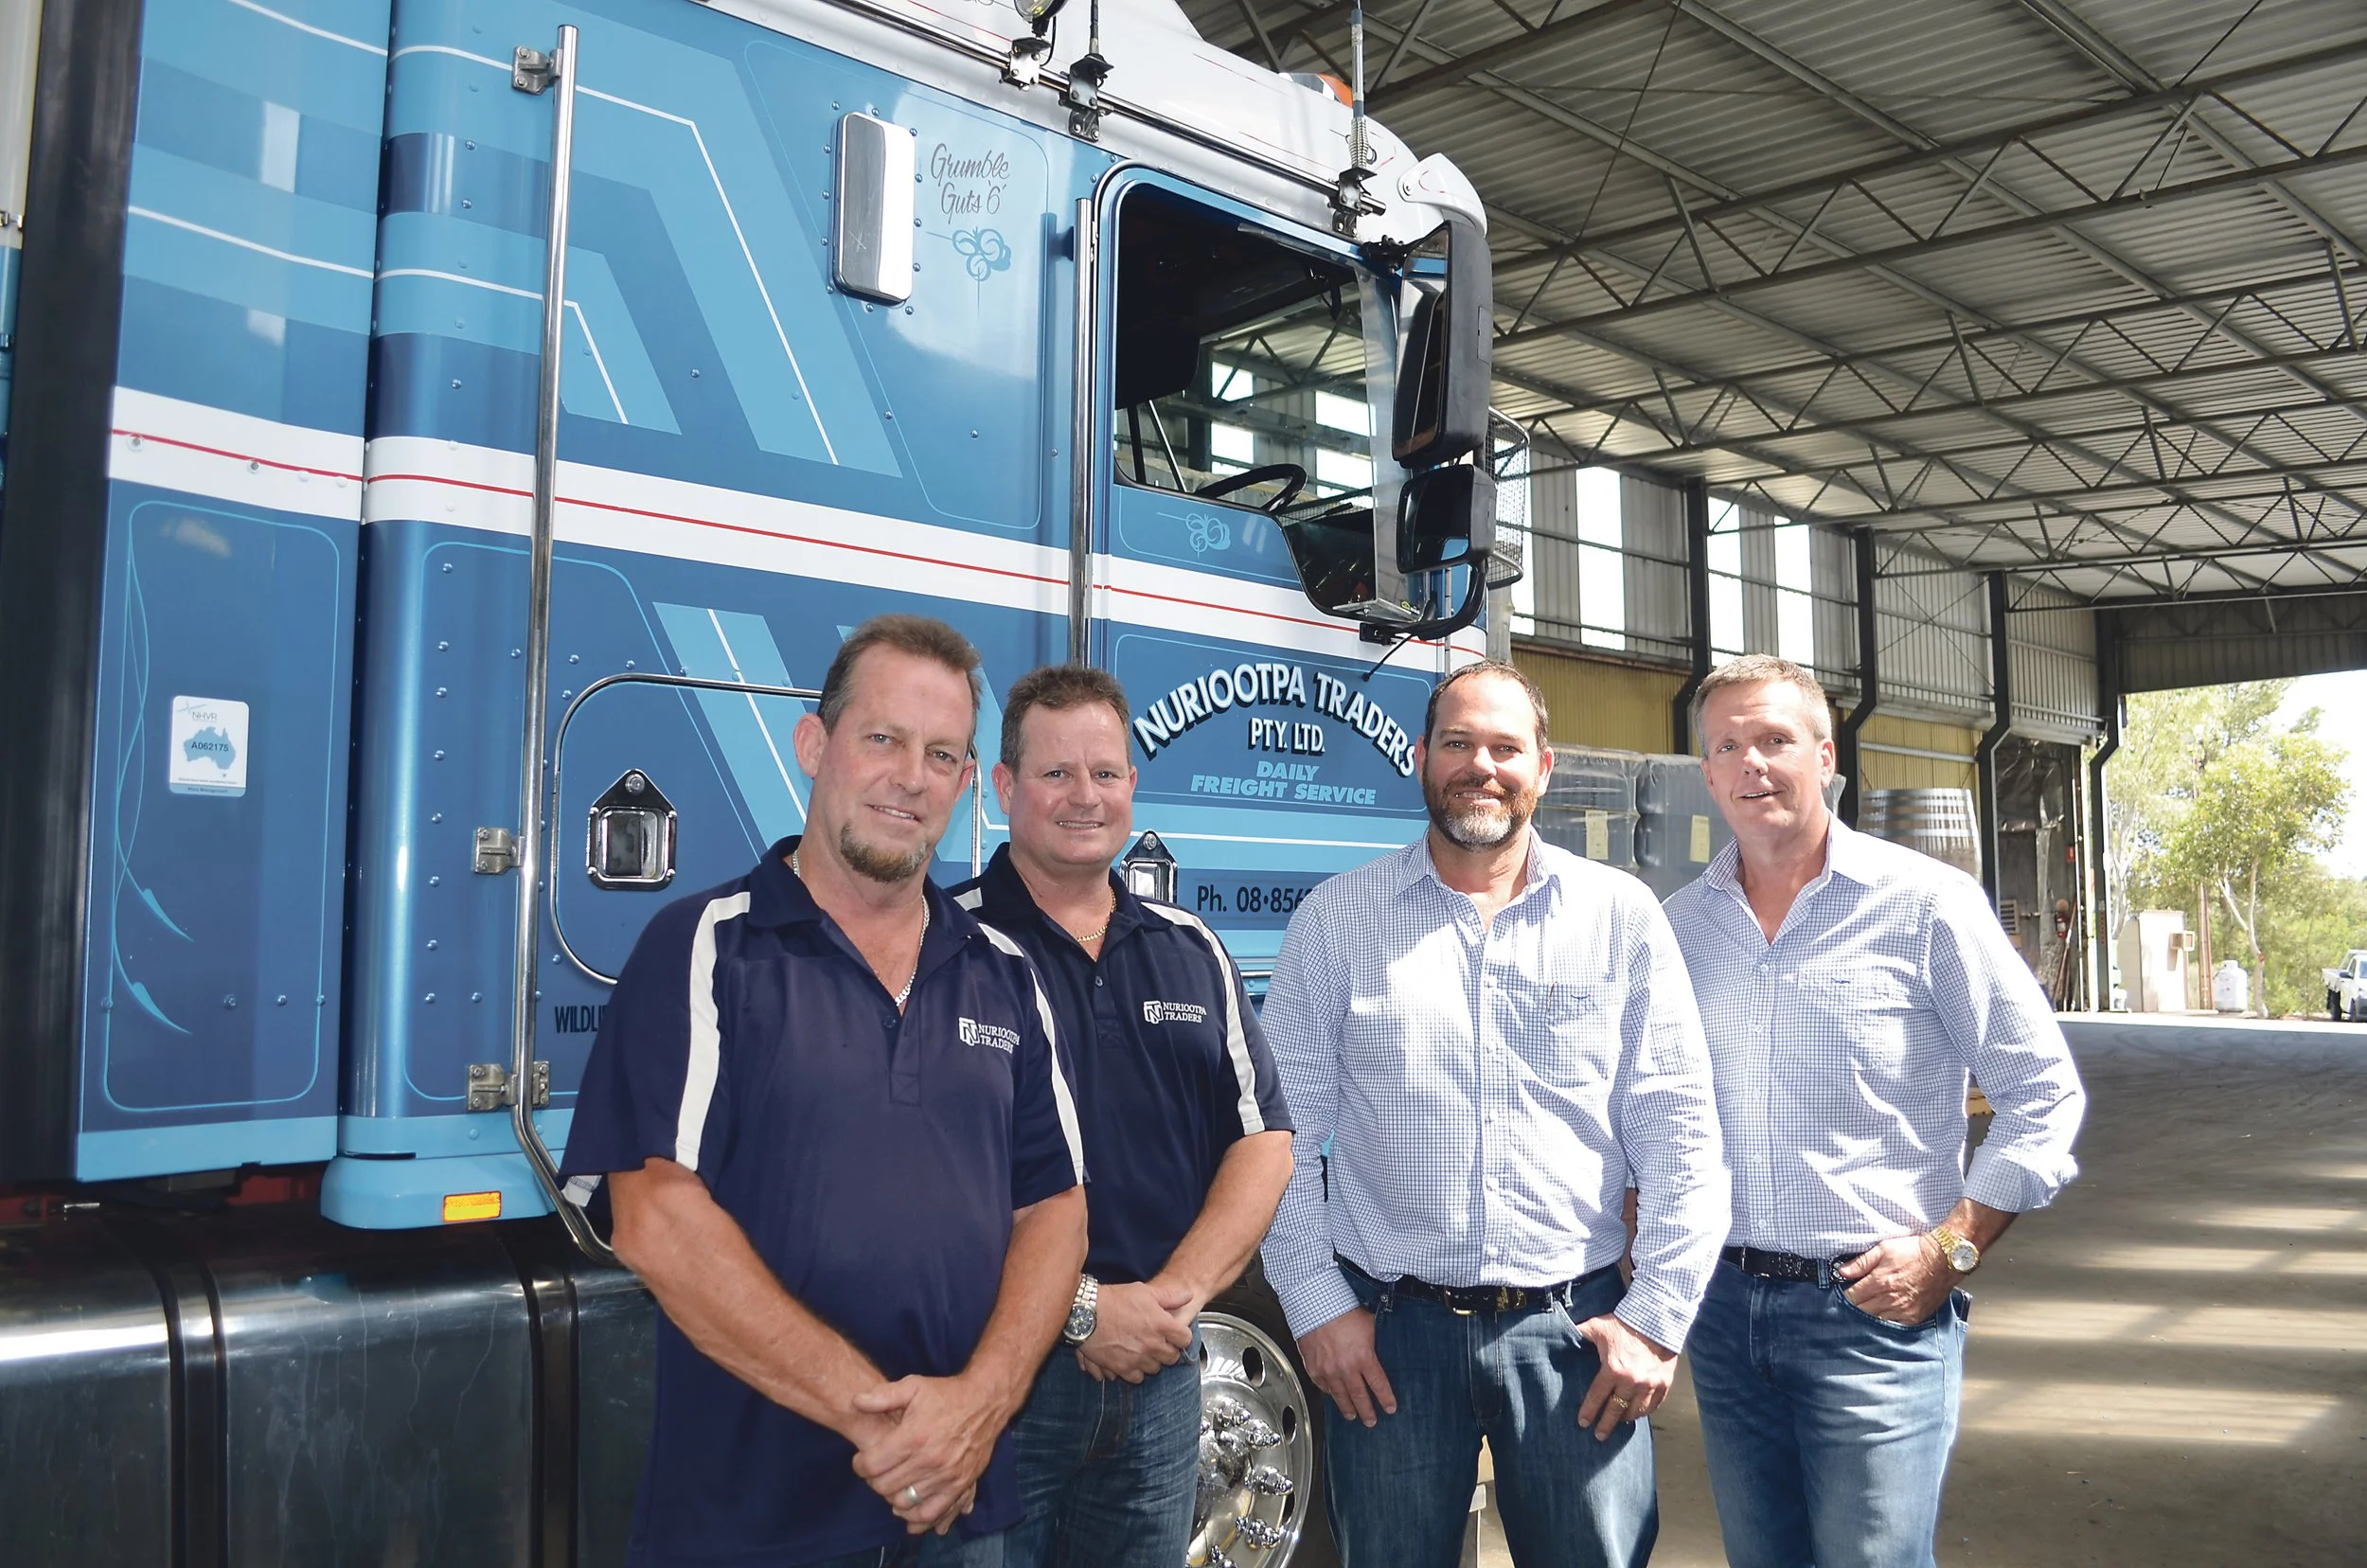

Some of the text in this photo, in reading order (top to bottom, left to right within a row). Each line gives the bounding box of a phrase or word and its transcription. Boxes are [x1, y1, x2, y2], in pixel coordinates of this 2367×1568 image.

[931, 143, 1010, 187] Grumble
[940, 182, 982, 224] Guts
[1133, 663, 1416, 778] NURIOOTPA TRADERS
[191, 741, 229, 752] A062175
[1256, 760, 1320, 781] DAILY
[1190, 775, 1378, 806] FREIGHT SERVICE
[1197, 884, 1228, 912] Ph.
[1165, 1011, 1202, 1024] TRADERS
